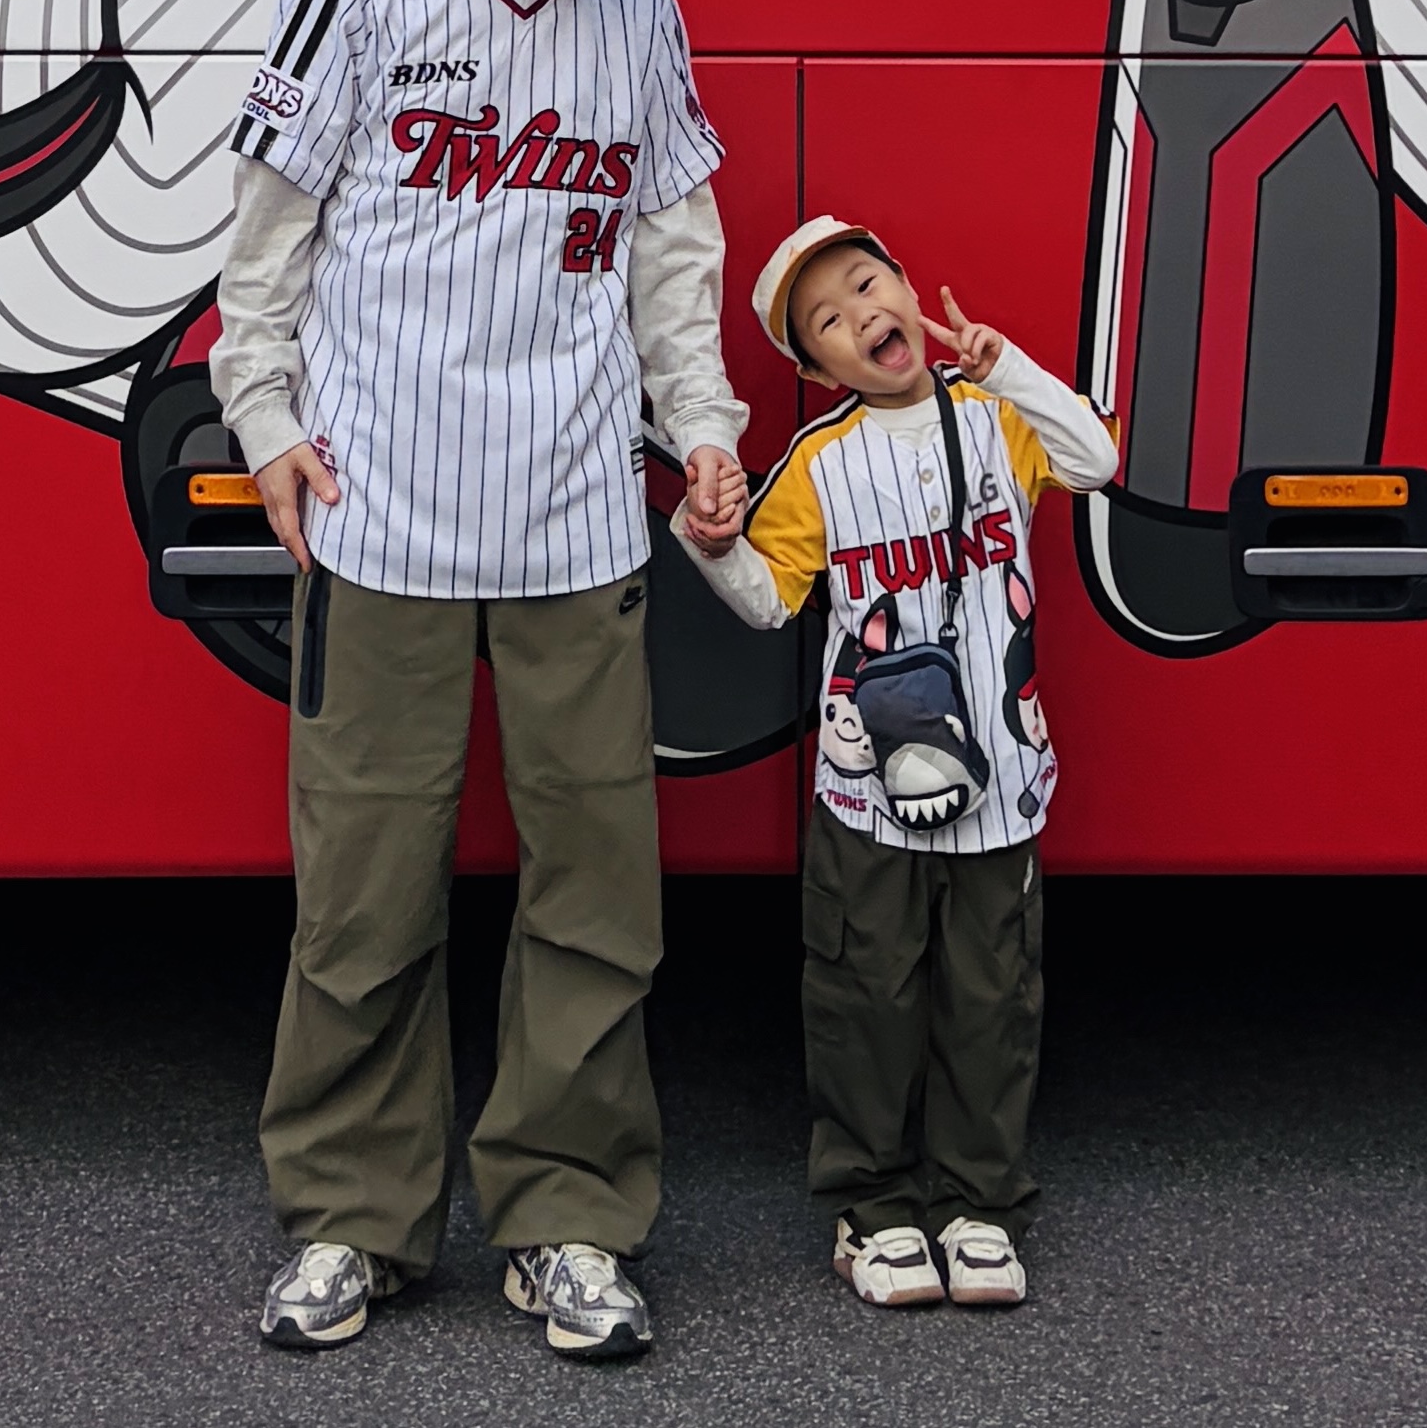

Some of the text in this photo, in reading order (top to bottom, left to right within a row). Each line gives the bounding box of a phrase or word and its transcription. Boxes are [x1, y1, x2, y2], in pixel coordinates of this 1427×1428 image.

[389, 60, 480, 87] BDNS
[242, 100, 271, 122] OUL
[391, 104, 641, 203] Twins
[562, 207, 624, 273] 24
[830, 507, 1017, 600] TWINS
[825, 788, 869, 813] TWINS
